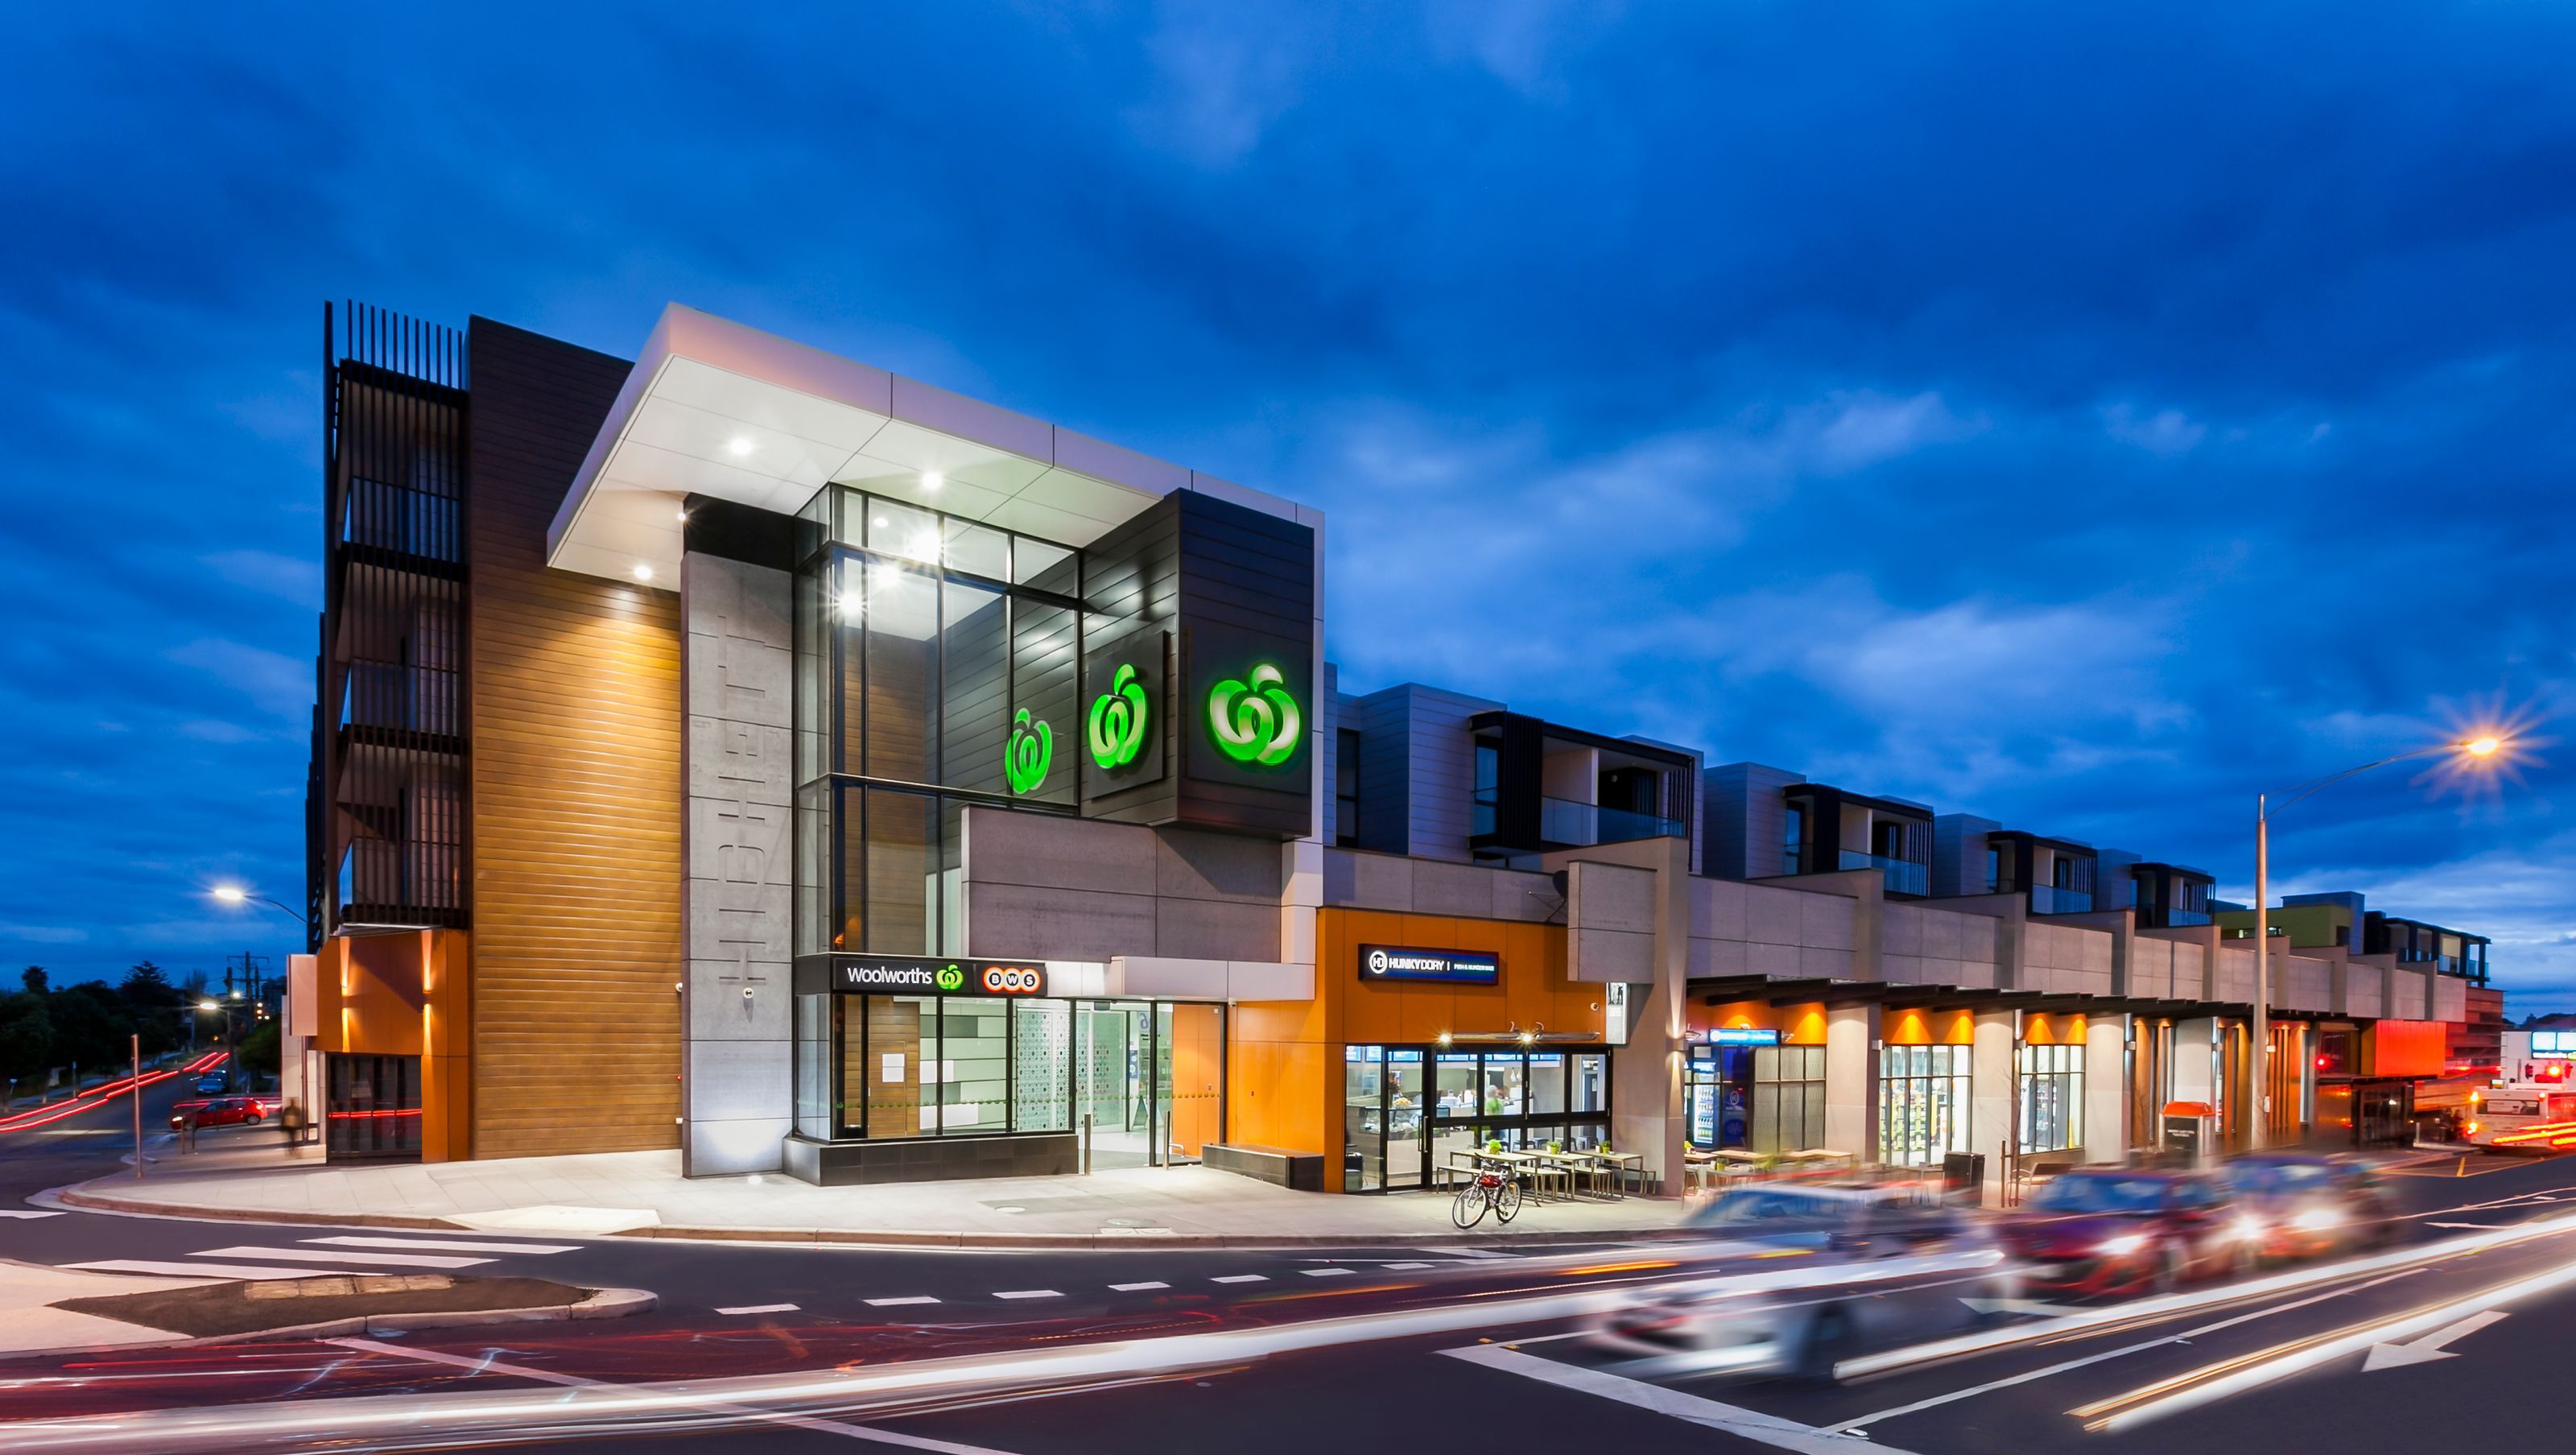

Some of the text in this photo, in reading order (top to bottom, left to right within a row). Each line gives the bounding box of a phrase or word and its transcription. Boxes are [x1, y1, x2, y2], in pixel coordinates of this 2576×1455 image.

[717, 614, 766, 986] HIGHETT
[847, 965, 933, 985] Woolworths
[991, 974, 1034, 986] BWS
